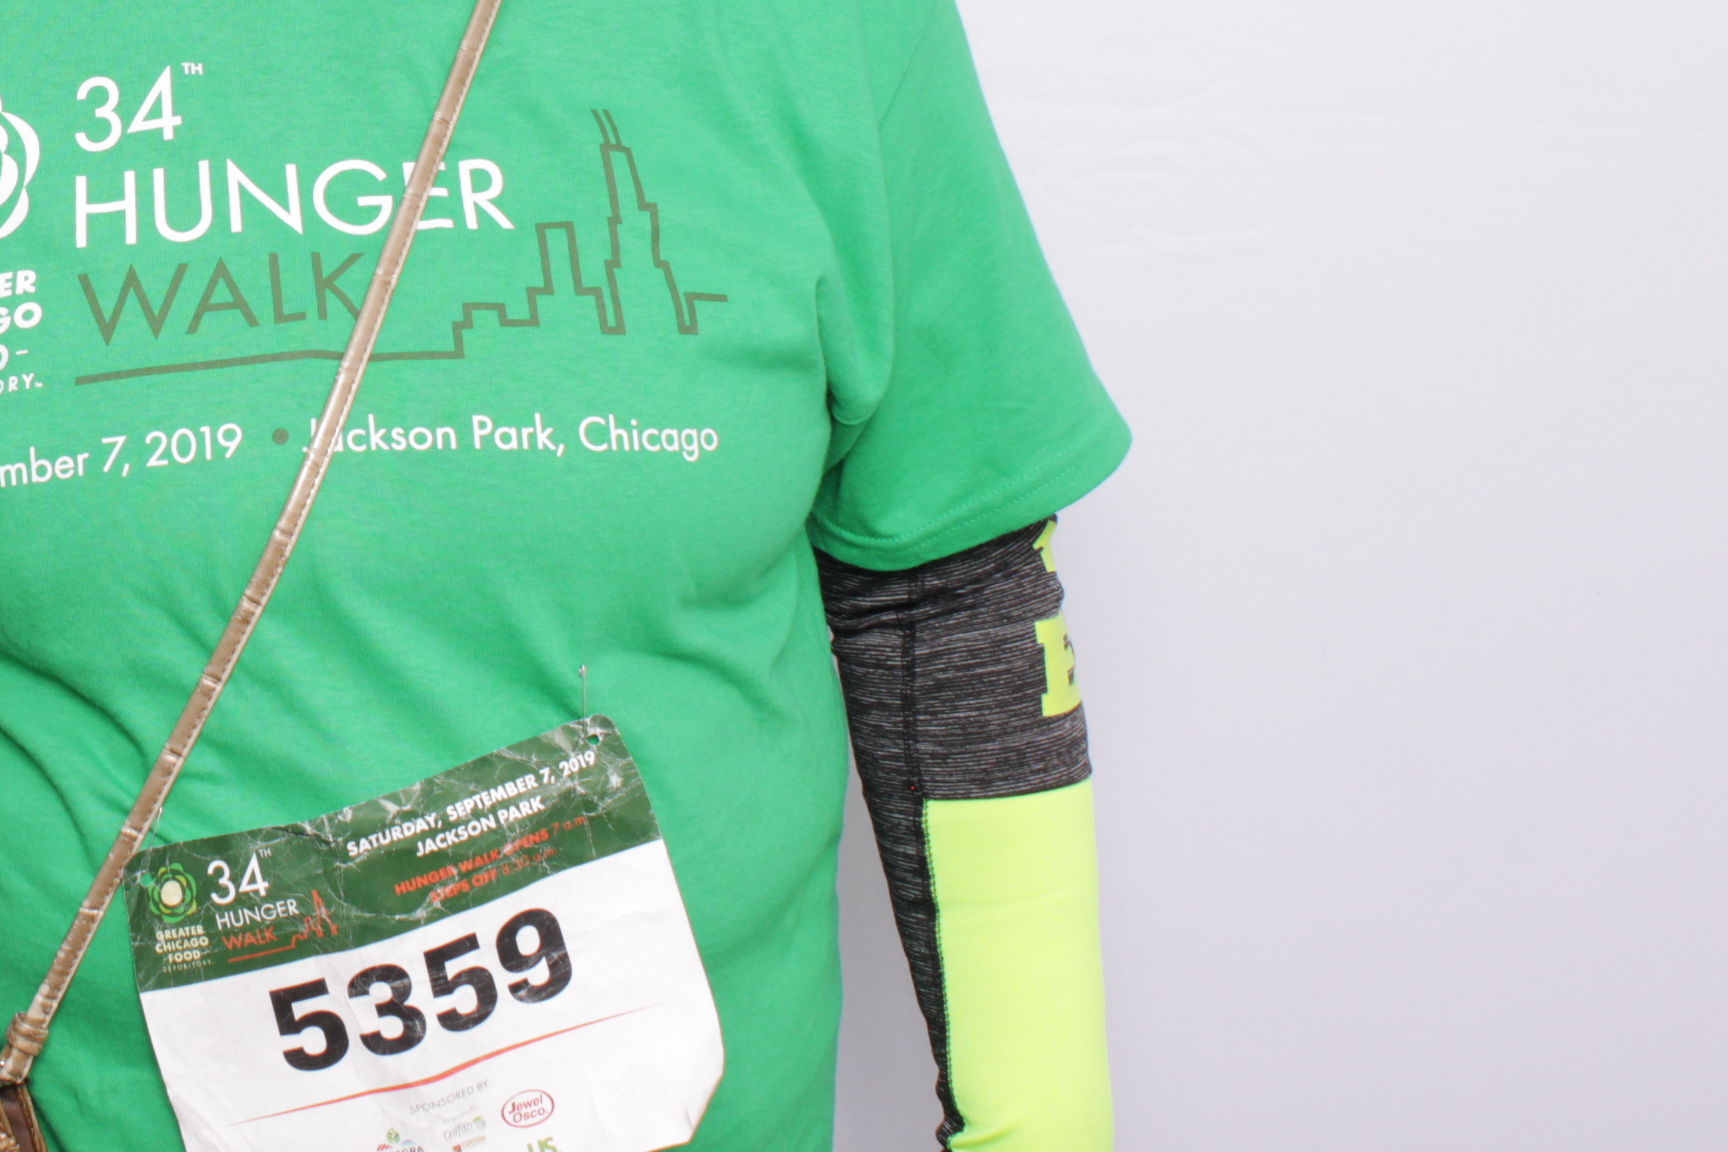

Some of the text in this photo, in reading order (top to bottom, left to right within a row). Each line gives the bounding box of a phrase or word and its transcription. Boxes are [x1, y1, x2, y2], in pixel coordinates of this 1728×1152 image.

[75, 159, 515, 248] HUNGER
[77, 252, 364, 346] WALK
[101, 436, 130, 477] 7,
[145, 423, 243, 468] 2019
[472, 413, 565, 456] Park,
[578, 415, 719, 462] Chicago
[346, 750, 596, 857] SATURDAY, SEPTEMBER 7, 2019
[416, 795, 546, 857] JACKSON PARK
[394, 865, 457, 896] HUNGER
[458, 848, 501, 874] WALK
[502, 828, 550, 857] OPENS
[429, 876, 471, 903] STEPS
[471, 868, 498, 888] OFF
[156, 925, 205, 941] GREATER
[215, 899, 300, 931] HUNGER
[222, 926, 279, 951] WALK
[155, 936, 209, 954] CHICAGO
[268, 907, 573, 1072] 5359
[409, 1086, 475, 1114] SPONSORED
[508, 1093, 544, 1115] Jewel
